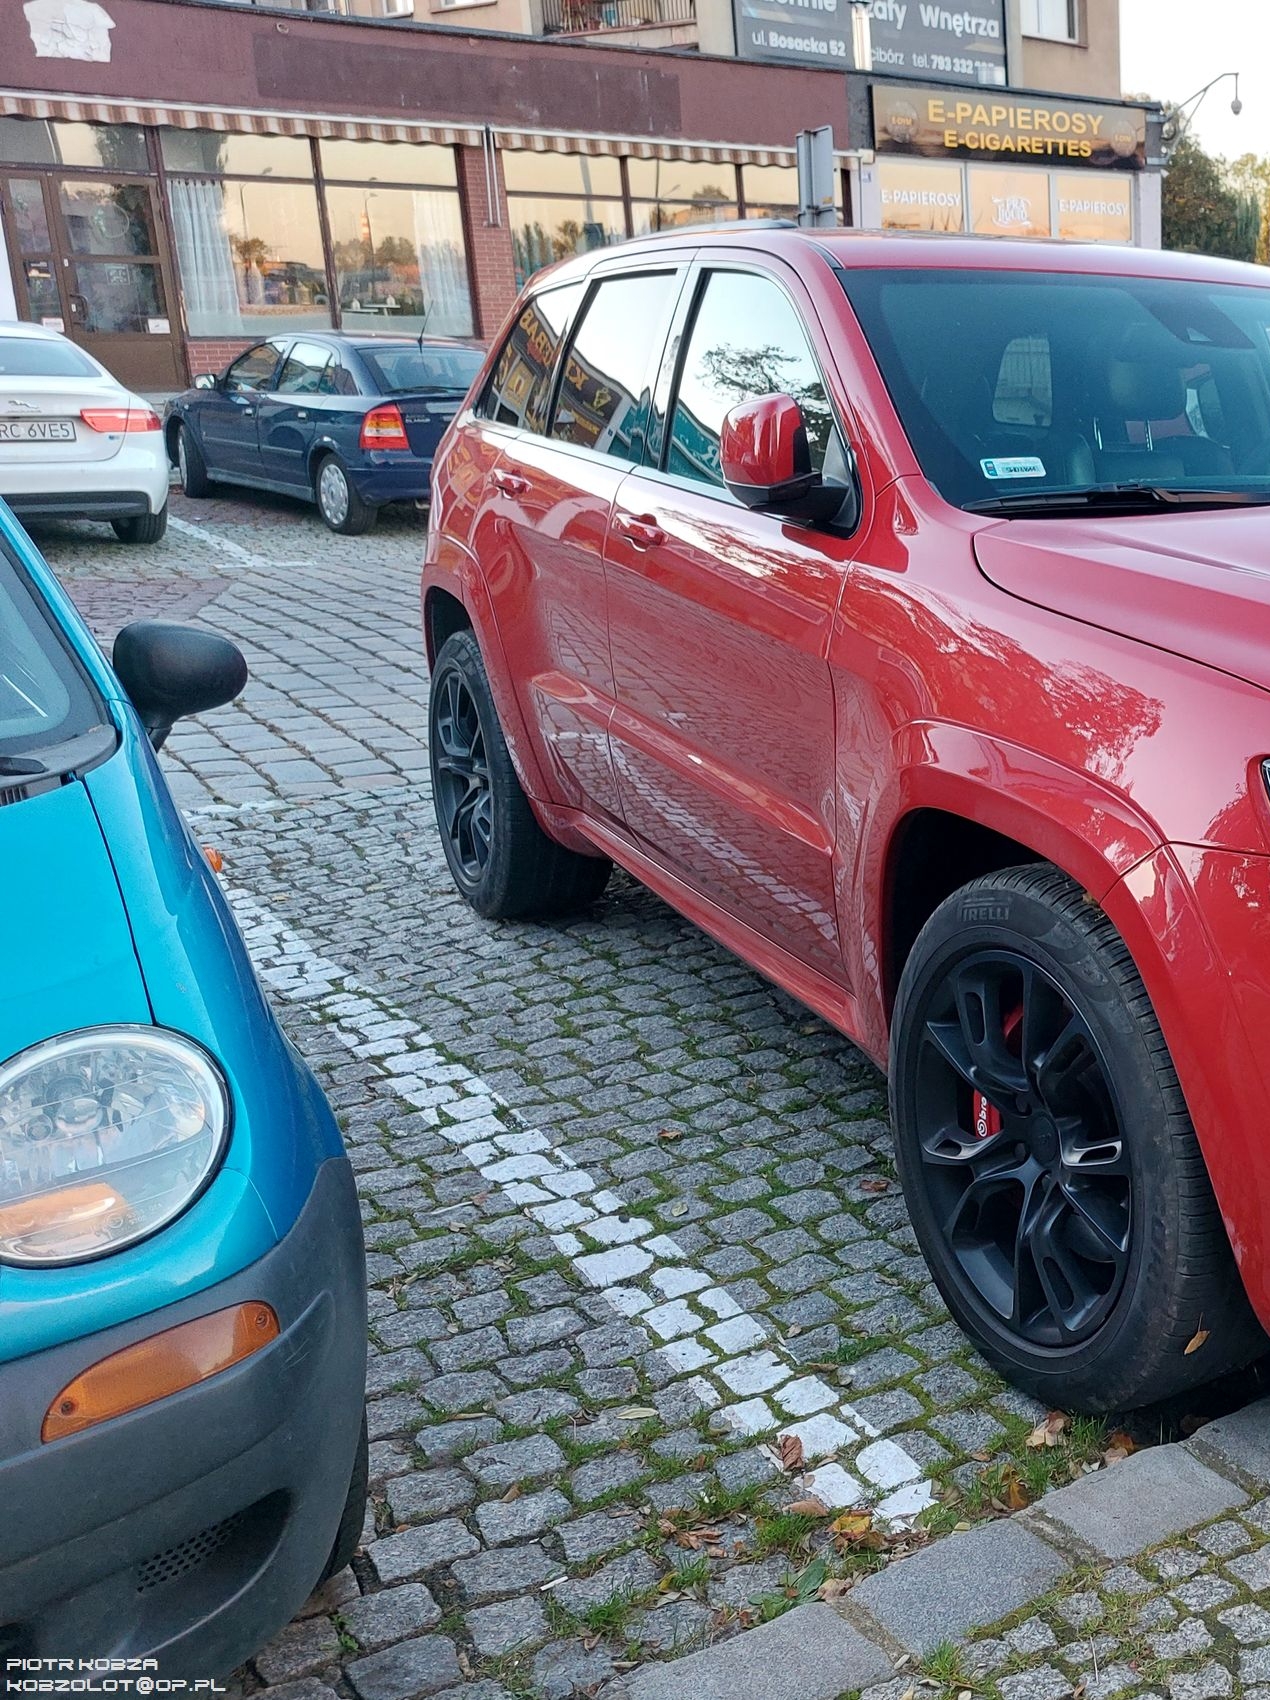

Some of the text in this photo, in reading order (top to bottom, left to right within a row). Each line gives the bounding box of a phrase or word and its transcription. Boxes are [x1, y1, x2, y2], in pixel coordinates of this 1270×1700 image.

[919, 3, 1000, 38] Wnętrza
[752, 30, 768, 47] ul.
[769, 31, 828, 55] Bosacka
[829, 39, 847, 57] 52
[912, 53, 930, 69] tel.
[931, 54, 952, 72] 793
[953, 57, 974, 75] 332
[927, 98, 1103, 135] E-PAPIEROSY
[944, 129, 1093, 158] E-CIGARETTES
[881, 189, 962, 208] E-PAPIEROSY
[1059, 199, 1129, 217] E-PAPIEROSY
[28, 423, 70, 439] 6VE5
